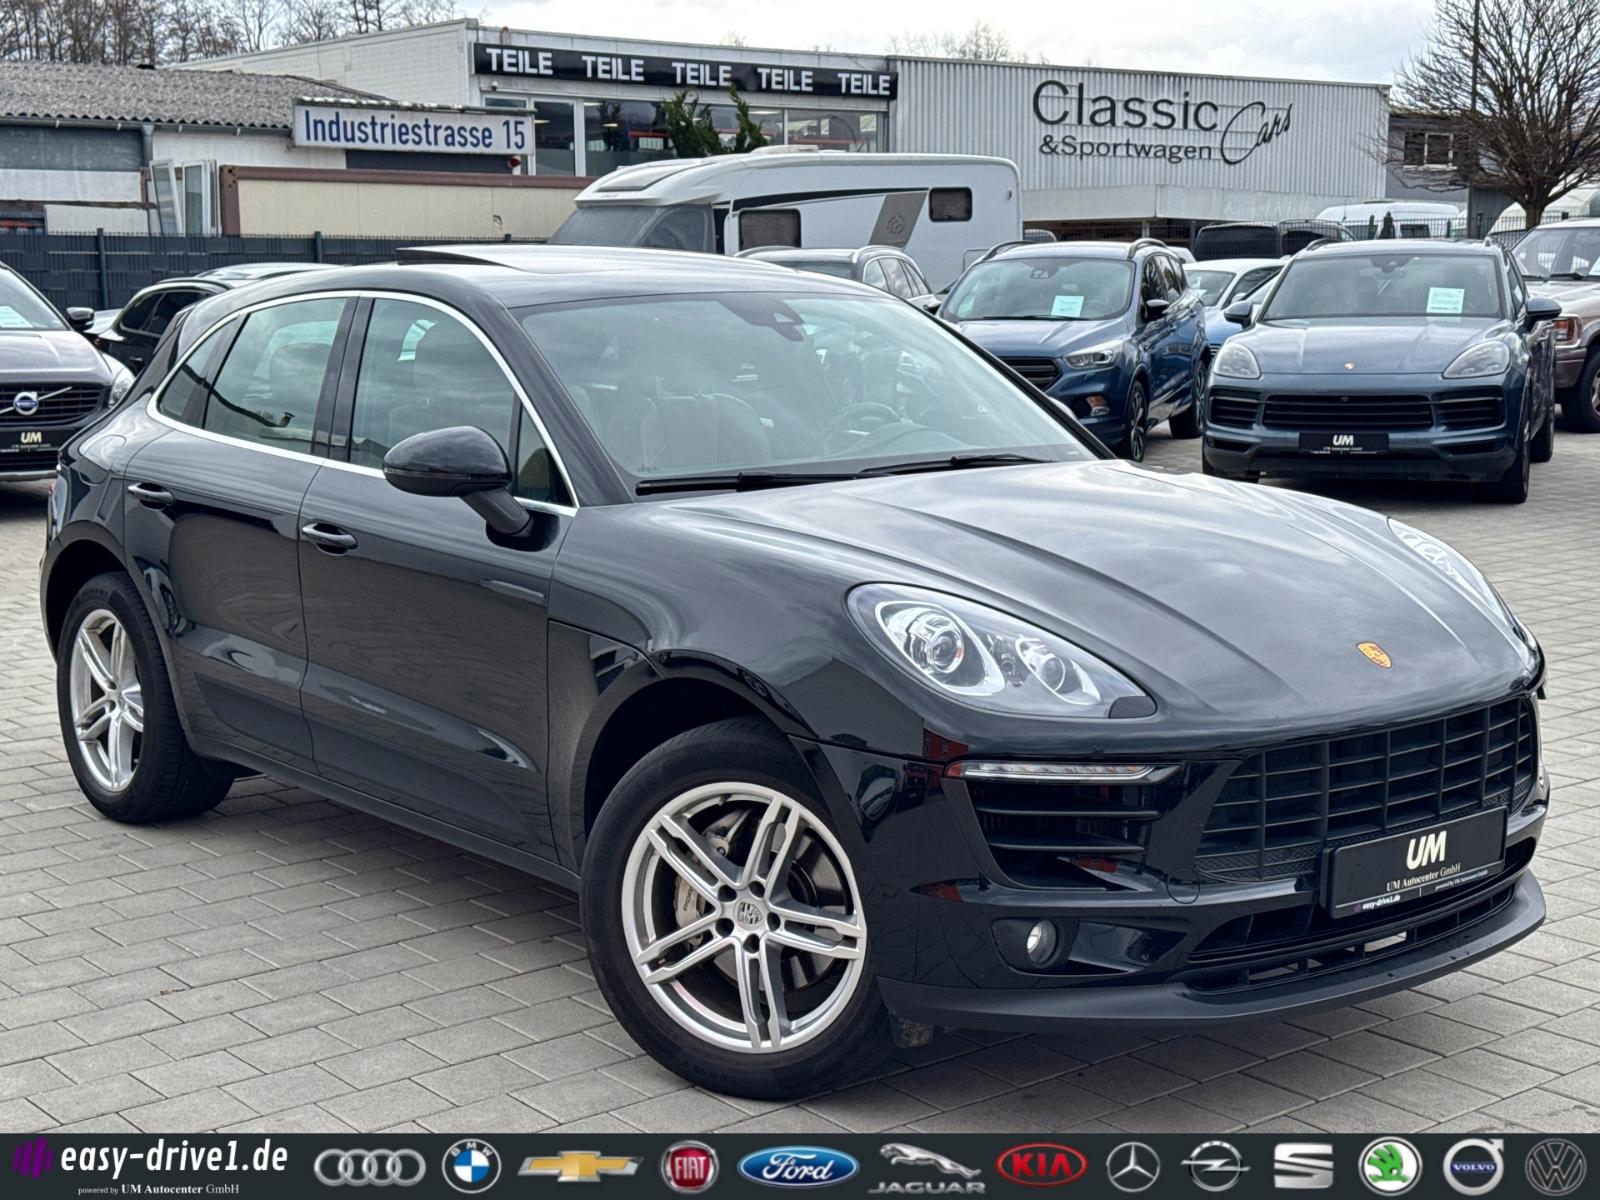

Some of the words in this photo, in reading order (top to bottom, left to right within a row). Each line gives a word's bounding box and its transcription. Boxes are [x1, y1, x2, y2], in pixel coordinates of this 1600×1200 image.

[486, 47, 553, 76] TEILE
[582, 55, 645, 82] TEILE
[672, 62, 732, 87] TEILE
[757, 68, 814, 93] TEILE
[837, 72, 891, 96] TEILE
[305, 110, 493, 149] Industriestrasse
[502, 119, 525, 150] 15
[1033, 80, 1219, 131] Classic
[1221, 101, 1292, 165] Cars
[1039, 135, 1212, 163] &Sportwagen
[20, 431, 42, 443] UM
[1332, 434, 1354, 446] UM
[1406, 830, 1447, 870] UM
[1386, 880, 1400, 892] UM
[1402, 872, 1439, 888] Autocenter
